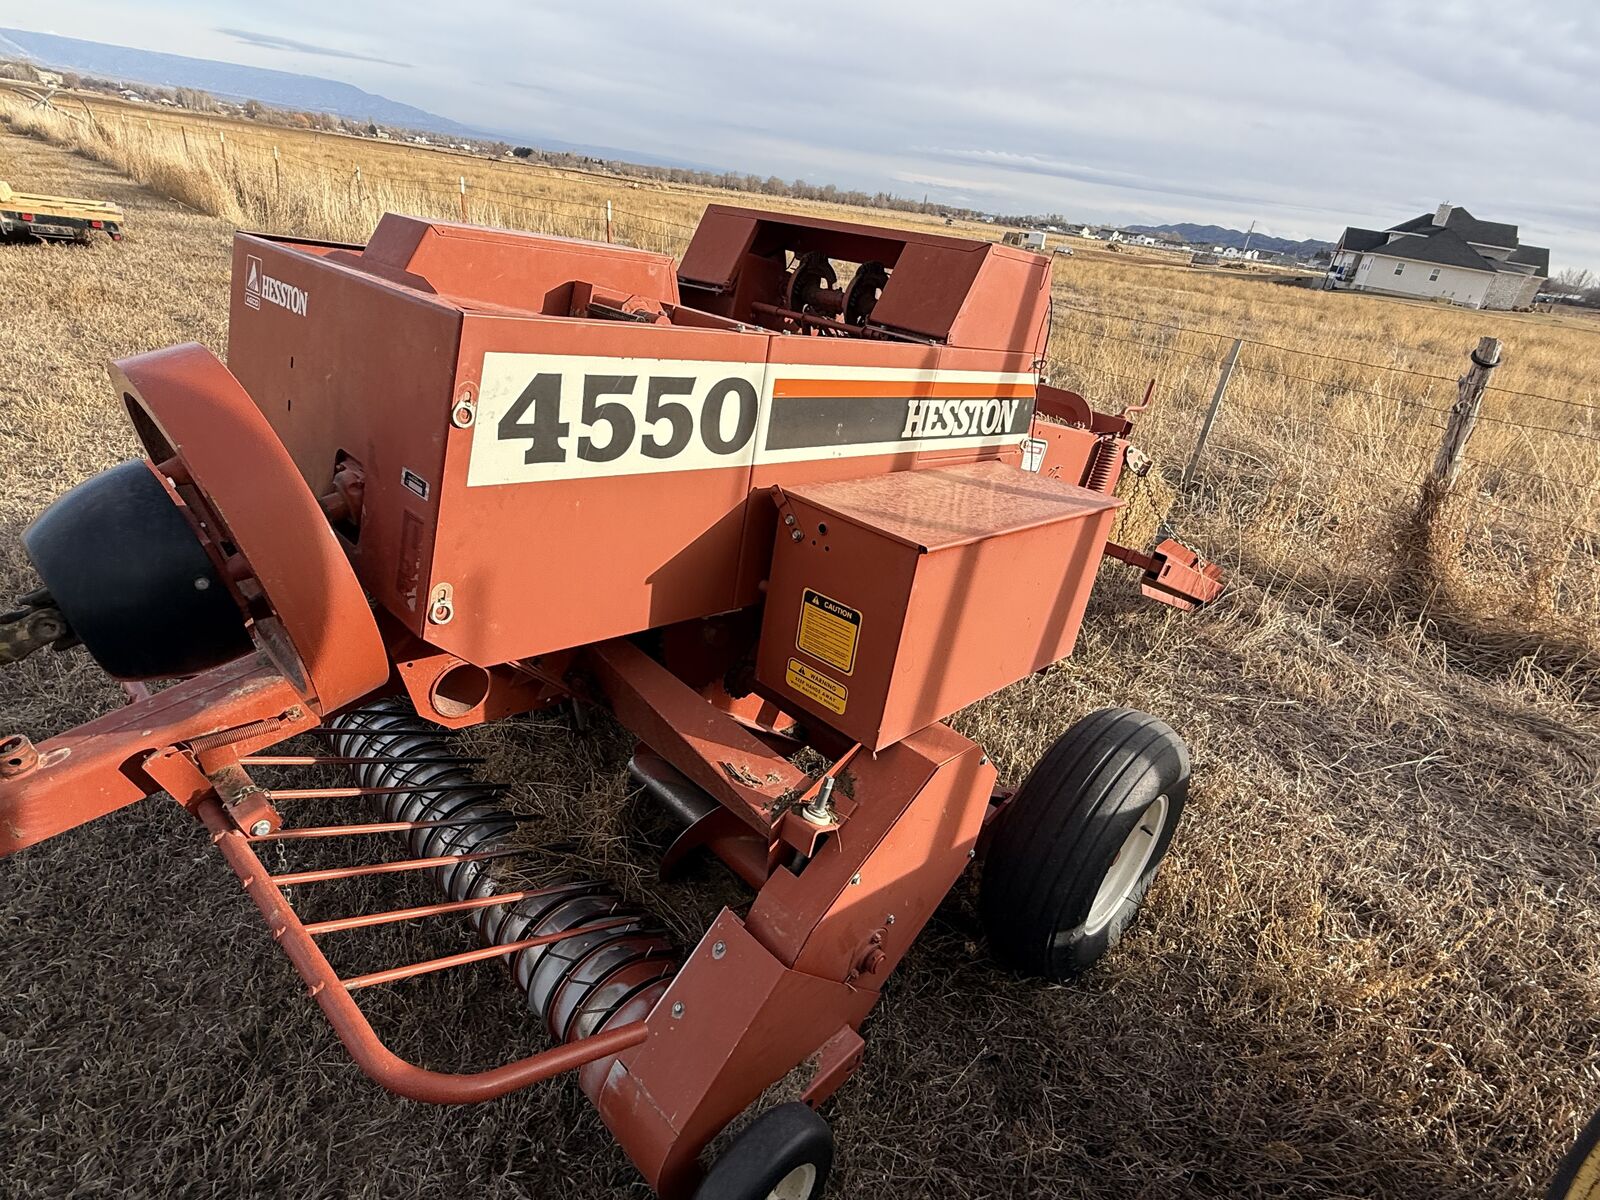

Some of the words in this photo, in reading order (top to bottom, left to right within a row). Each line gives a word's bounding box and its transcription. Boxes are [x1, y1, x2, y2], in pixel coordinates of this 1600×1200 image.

[261, 274, 309, 317] HESSTON
[498, 373, 758, 464] 4550
[901, 399, 1019, 438] HESSTON
[824, 602, 852, 619] CAUTION
[795, 676, 805, 684] KEEP
[805, 682, 821, 694] HANDS
[822, 691, 837, 702] AWAY
[809, 674, 837, 692] WARNING
